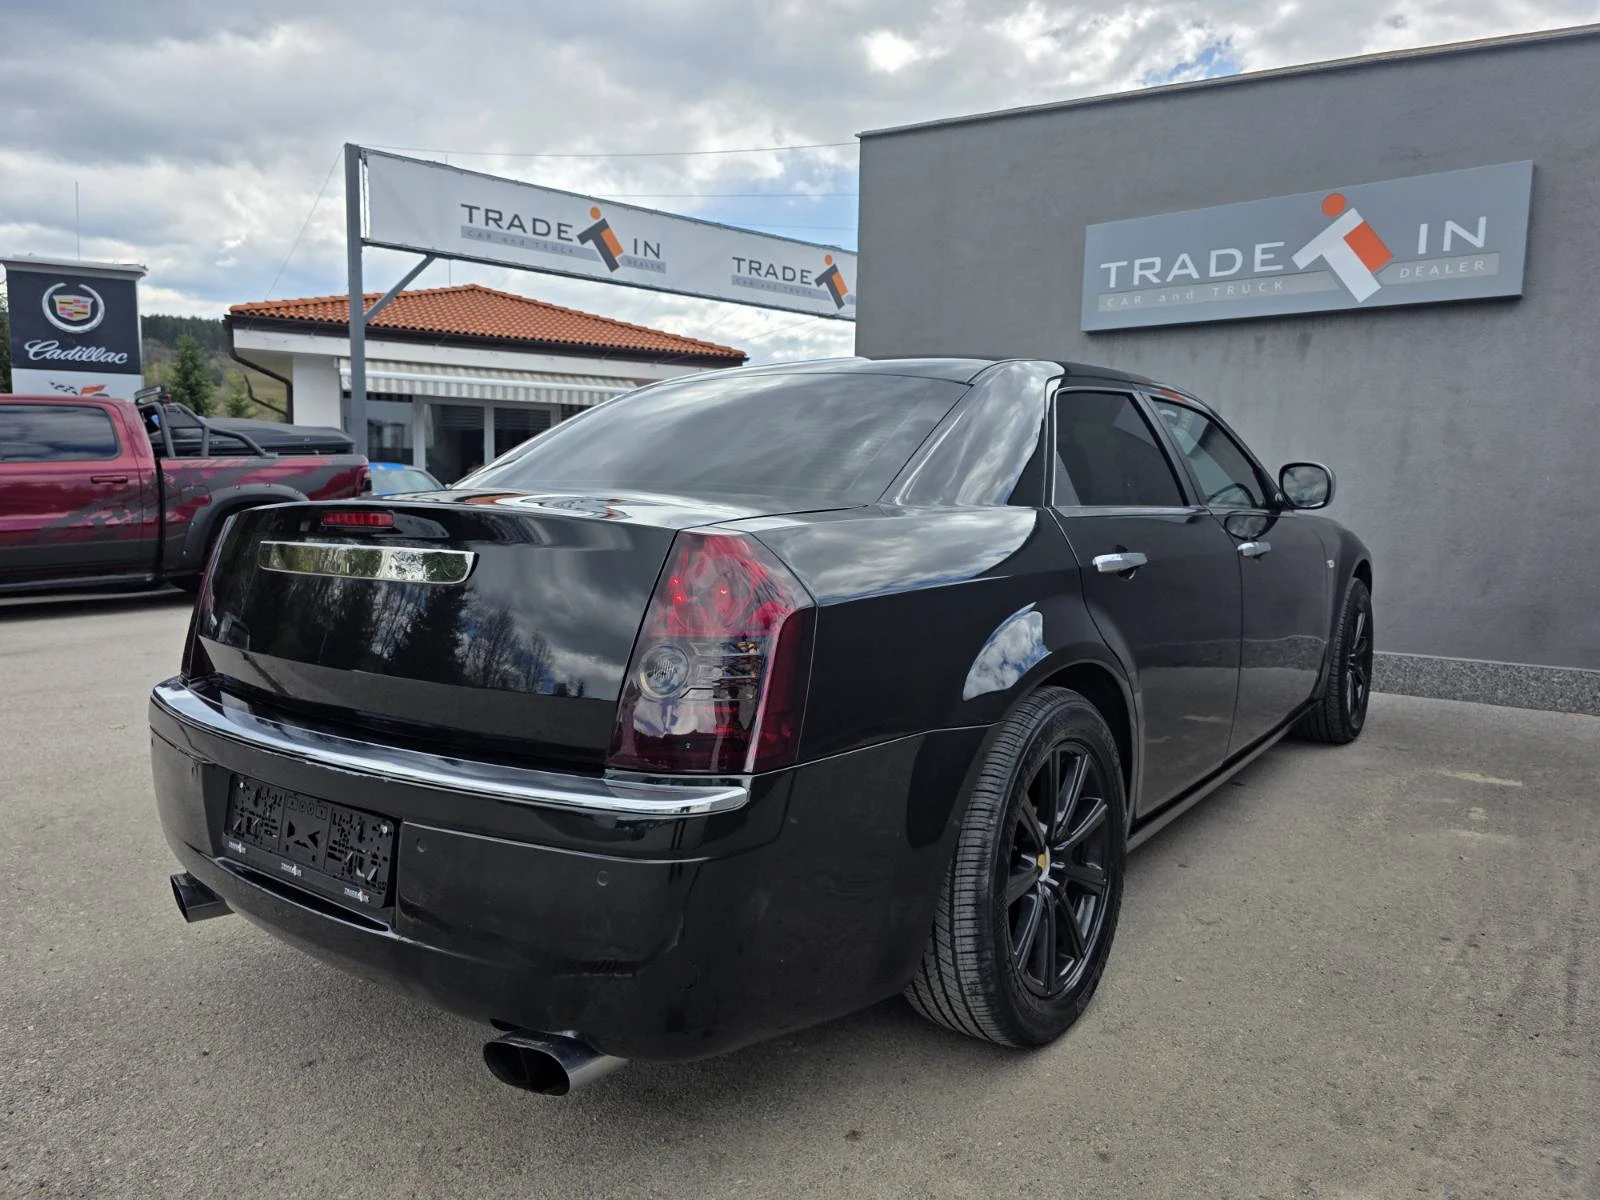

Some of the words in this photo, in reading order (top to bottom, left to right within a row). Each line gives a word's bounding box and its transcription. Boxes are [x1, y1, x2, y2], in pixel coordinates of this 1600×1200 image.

[461, 204, 573, 241] TRADE
[633, 237, 661, 260] IN
[1100, 241, 1286, 289] TRADE
[1418, 215, 1488, 255] IN
[732, 257, 812, 285] TRADE
[1399, 260, 1486, 279] DEALER
[1106, 294, 1142, 308] CAR
[1158, 289, 1195, 303] and
[1211, 280, 1283, 298] TRUCK
[24, 339, 128, 364] Cadillac
